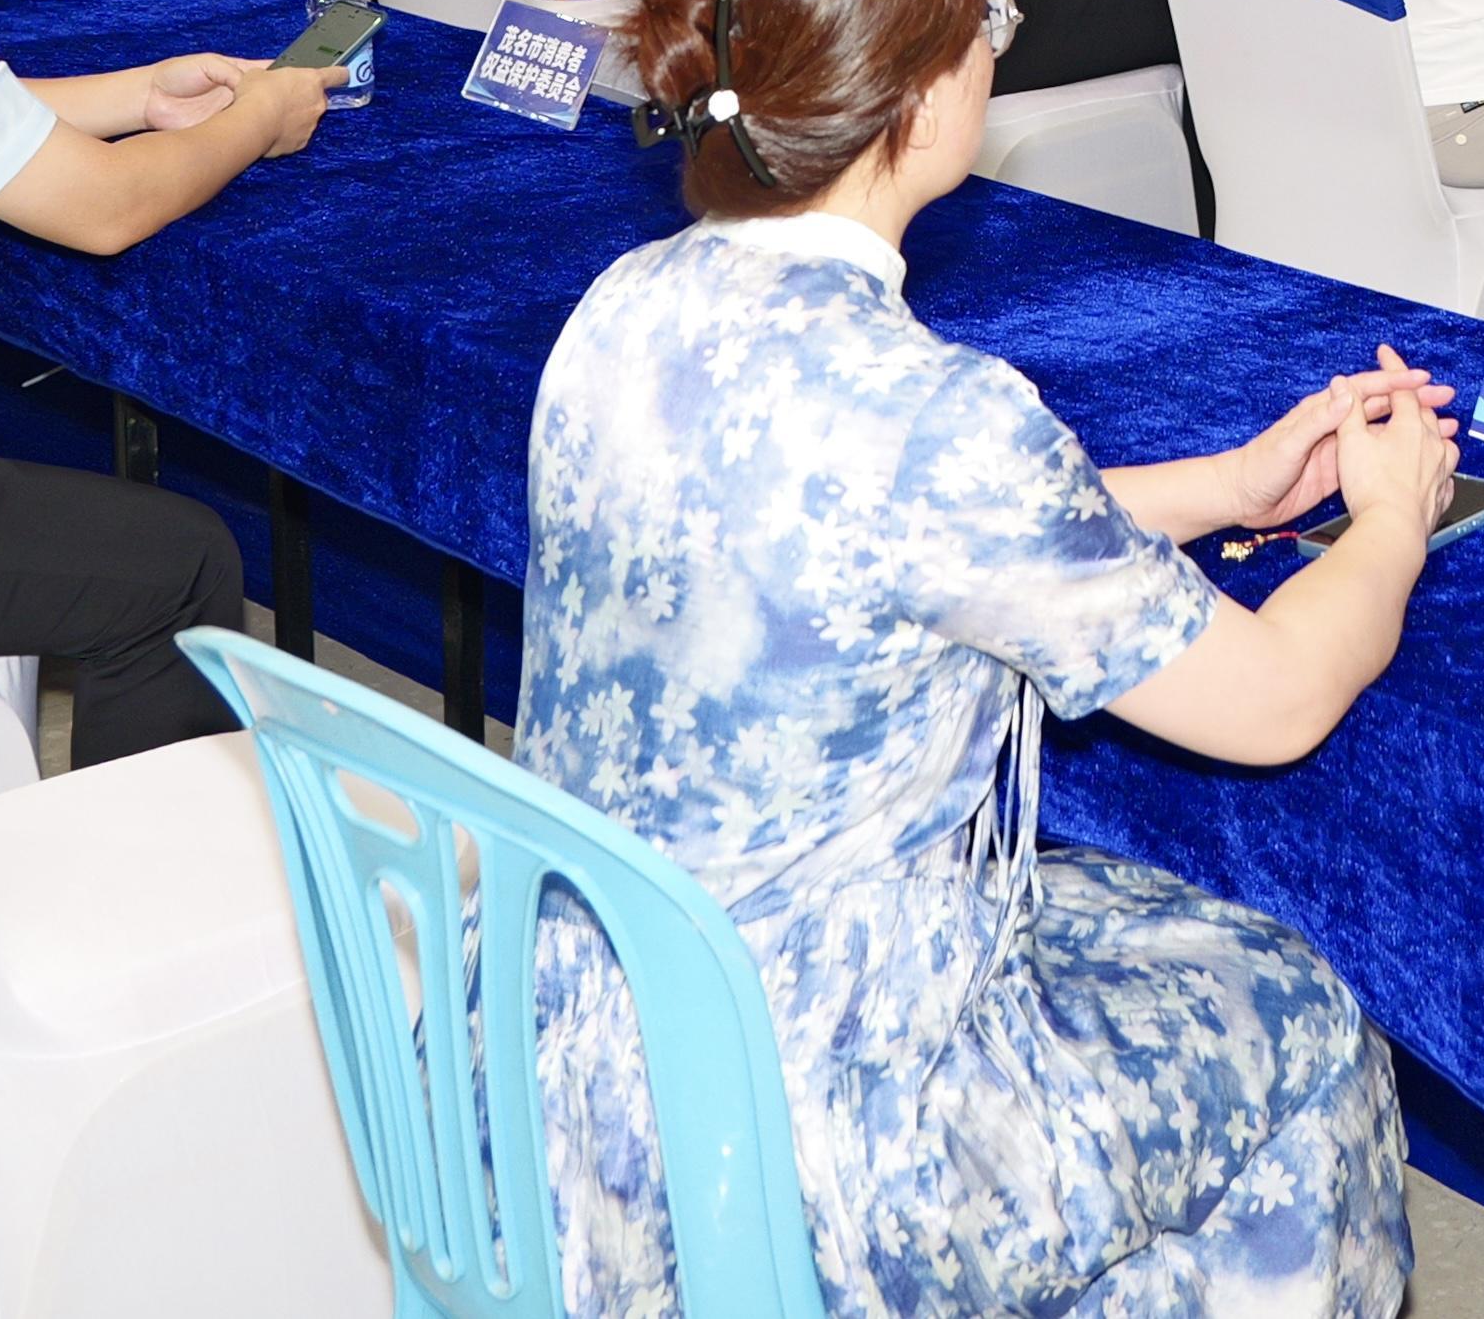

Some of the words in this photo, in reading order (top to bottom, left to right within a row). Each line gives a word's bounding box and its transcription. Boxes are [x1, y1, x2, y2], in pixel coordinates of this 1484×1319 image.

[496, 23, 588, 75] 茂名市消费者
[479, 50, 582, 106] 权益保护委员会
